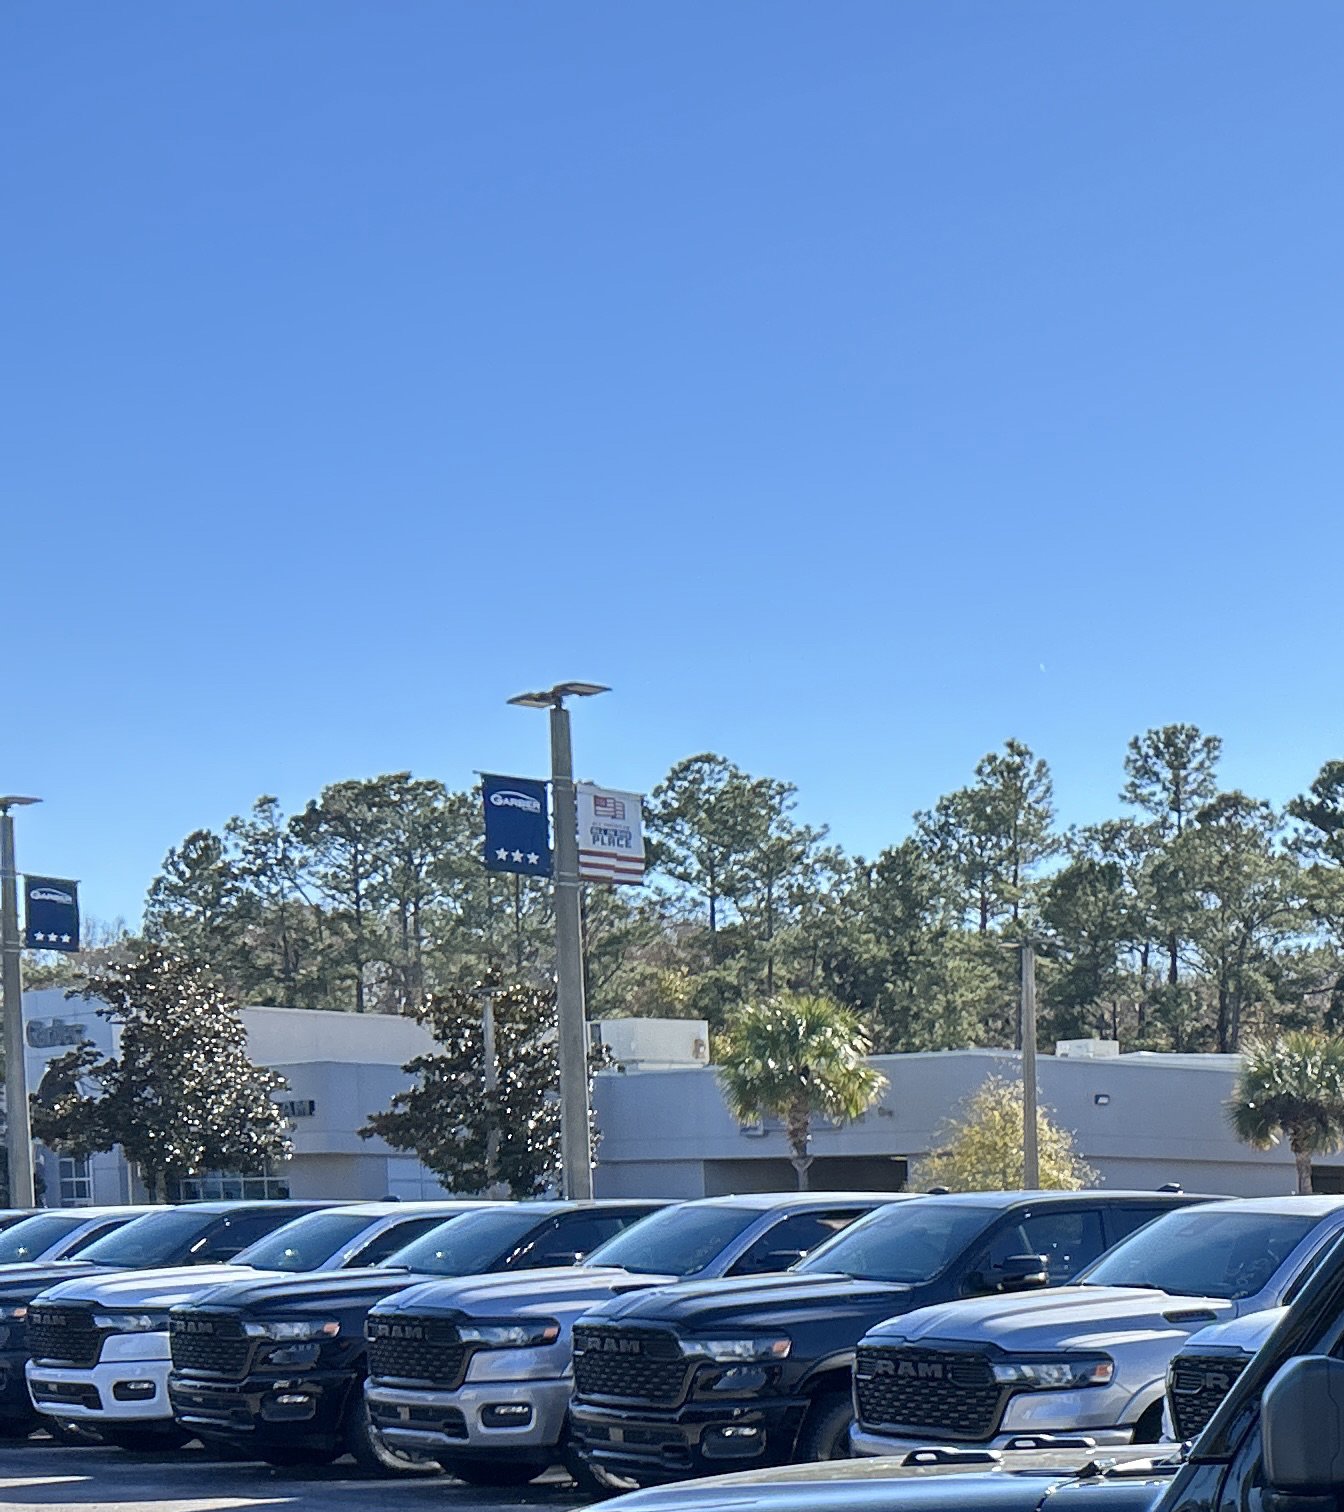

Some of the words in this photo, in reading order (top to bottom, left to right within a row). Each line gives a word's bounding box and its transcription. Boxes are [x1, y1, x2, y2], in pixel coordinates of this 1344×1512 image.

[378, 1324, 423, 1339] RAM
[587, 1336, 641, 1353] RAM
[875, 1359, 943, 1379] RAM
